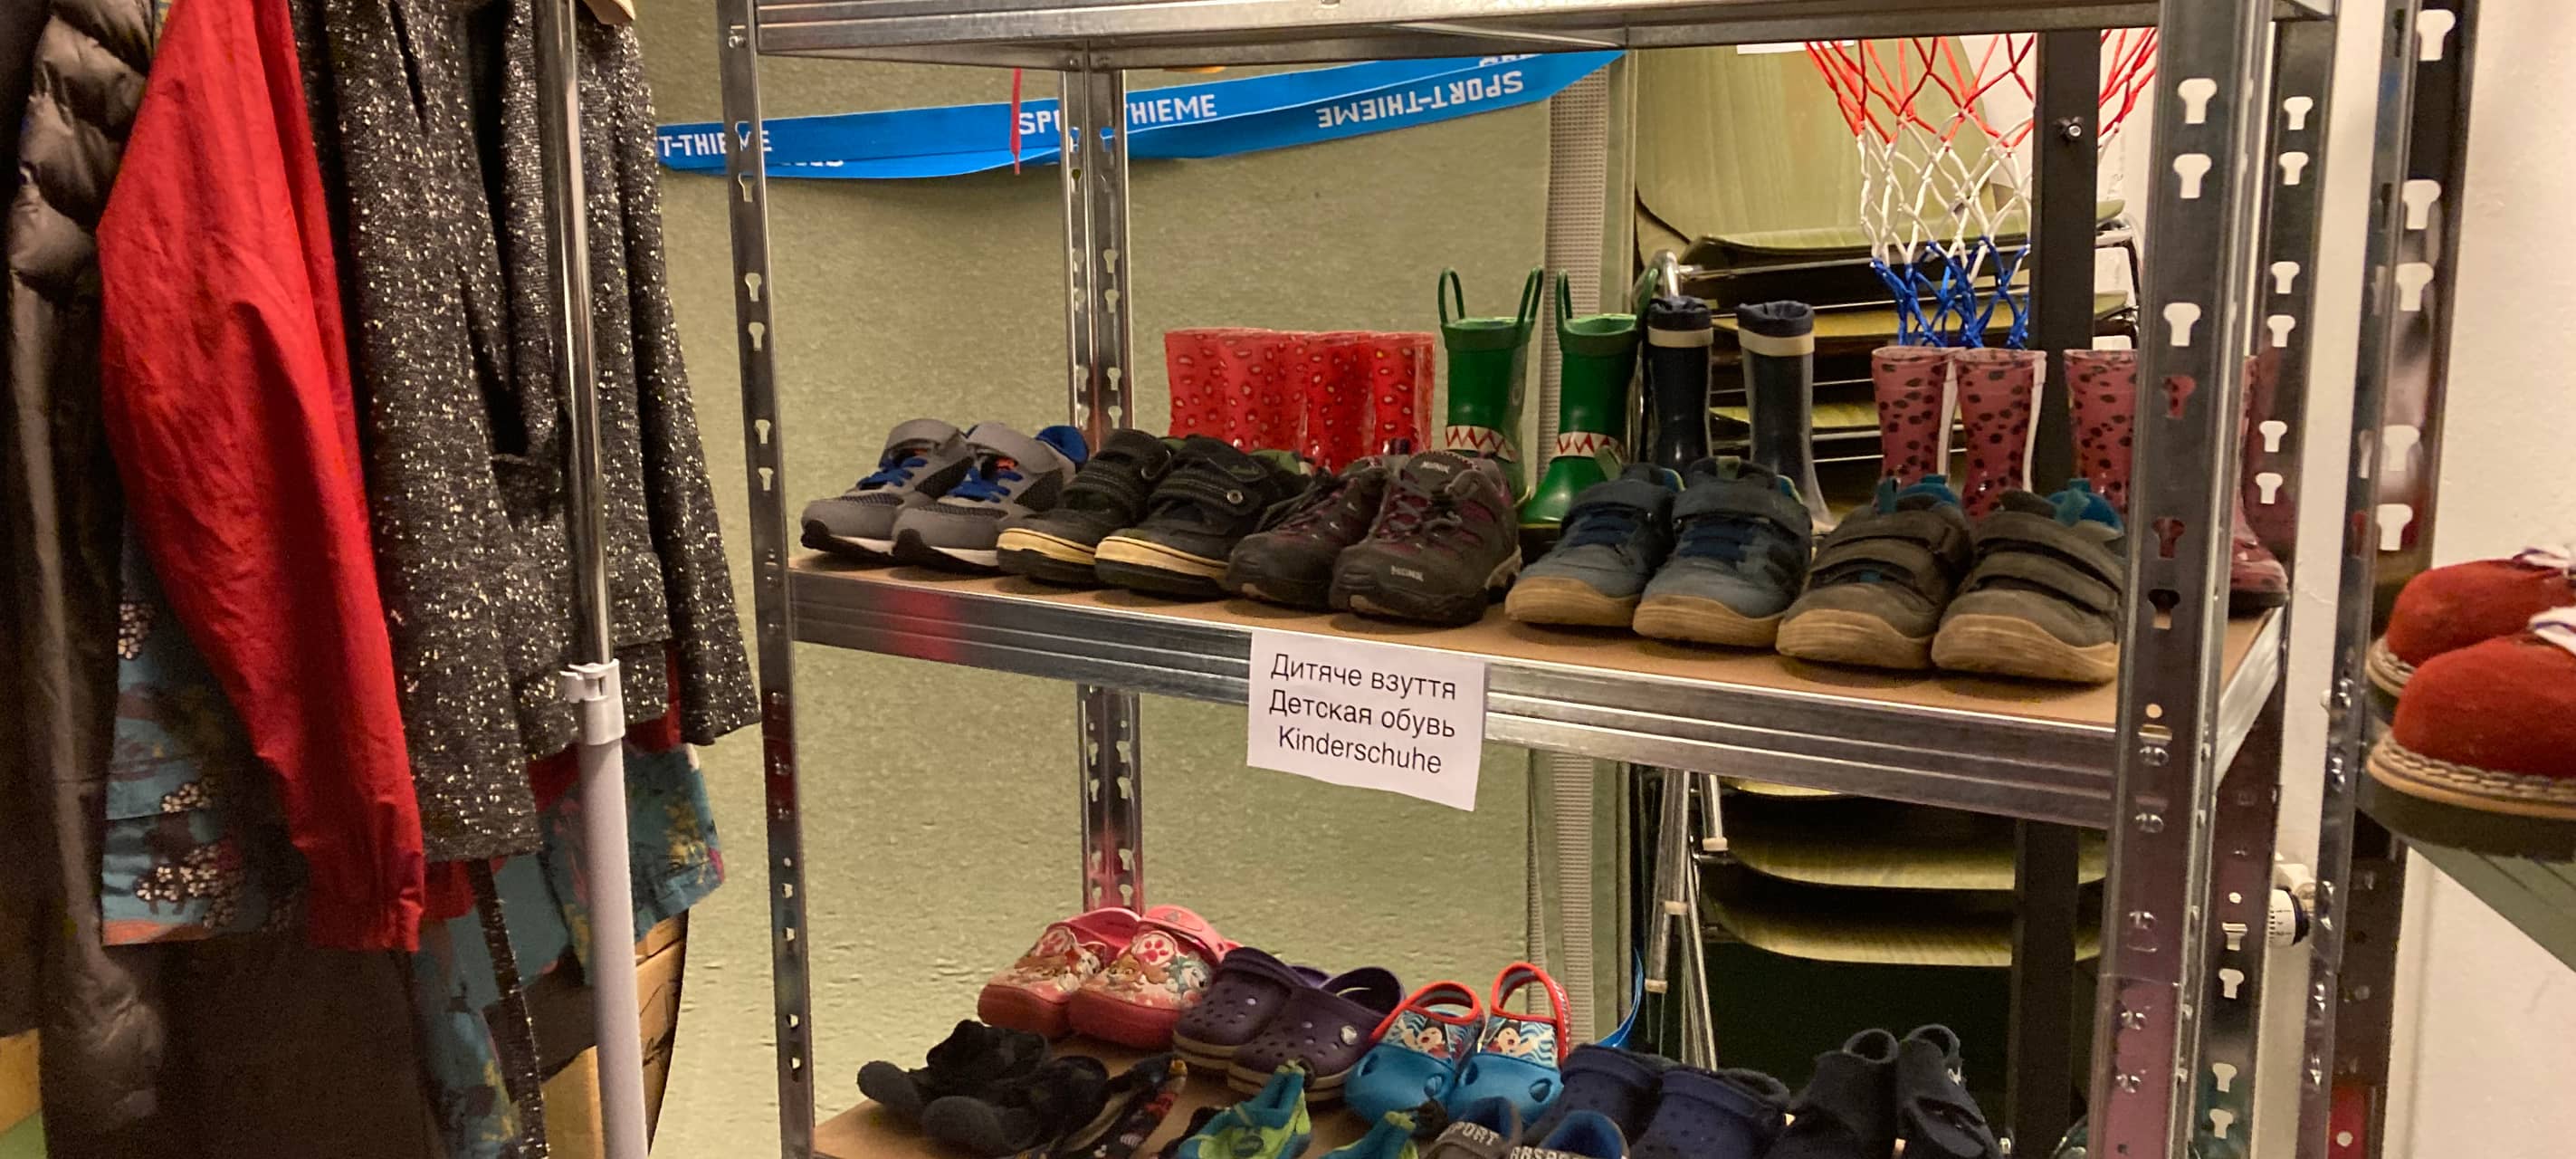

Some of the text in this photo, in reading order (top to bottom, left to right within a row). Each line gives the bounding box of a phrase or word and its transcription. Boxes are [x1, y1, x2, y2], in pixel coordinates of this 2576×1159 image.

[1315, 71, 1524, 129] SPORT-THIEME
[1270, 653, 1456, 700] Дитяче взуття
[1269, 689, 1455, 739] Детская обувь
[1278, 725, 1442, 774] Kinderschuhe
